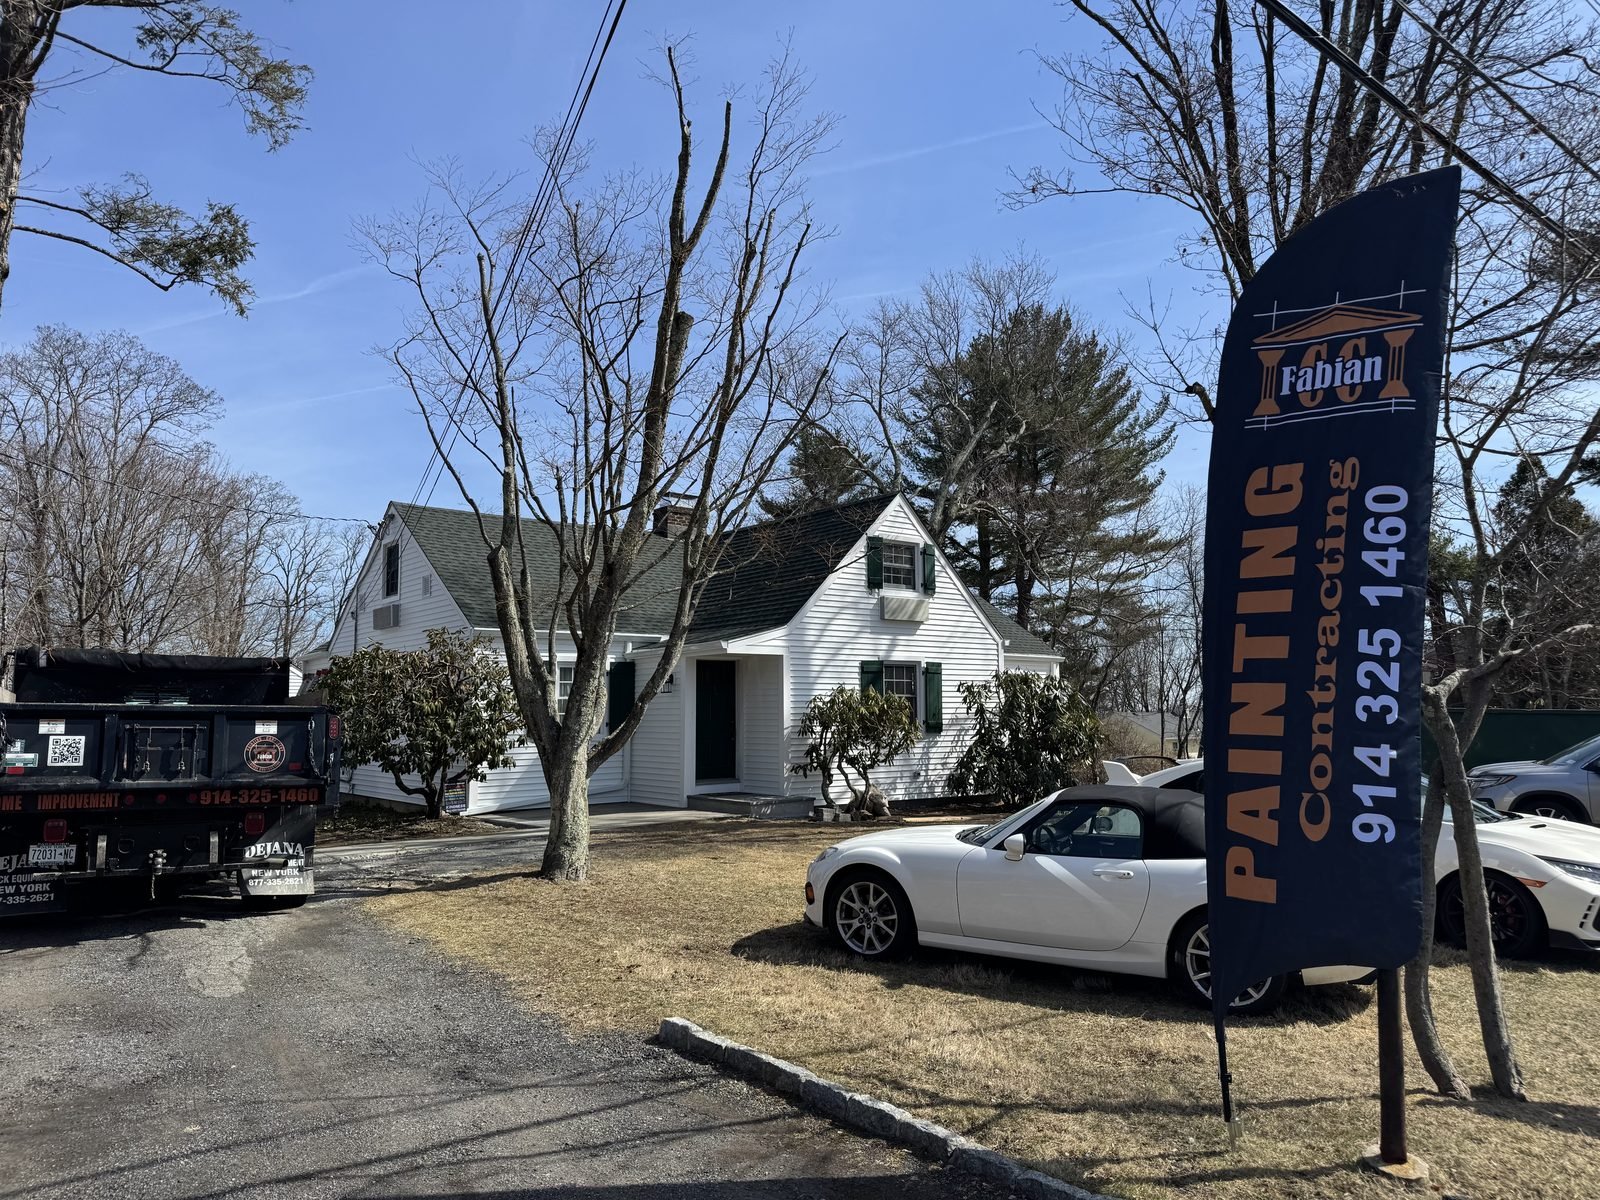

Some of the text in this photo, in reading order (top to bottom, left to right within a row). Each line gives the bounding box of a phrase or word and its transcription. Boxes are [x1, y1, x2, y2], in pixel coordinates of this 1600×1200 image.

[1280, 355, 1382, 396] Fabian
[1300, 456, 1361, 843] Contracting
[1352, 485, 1409, 844] 914 325 1460
[1225, 462, 1304, 904] PAINTING
[0, 793, 120, 811] ME IMPROVEMENT
[200, 788, 318, 805] 914-325-1460
[245, 841, 305, 858] DEJANA
[251, 868, 273, 877] NEW
[0, 882, 51, 894] EW YORK
[248, 877, 304, 887] 877-335-2621
[0, 893, 55, 905] -335-2621
